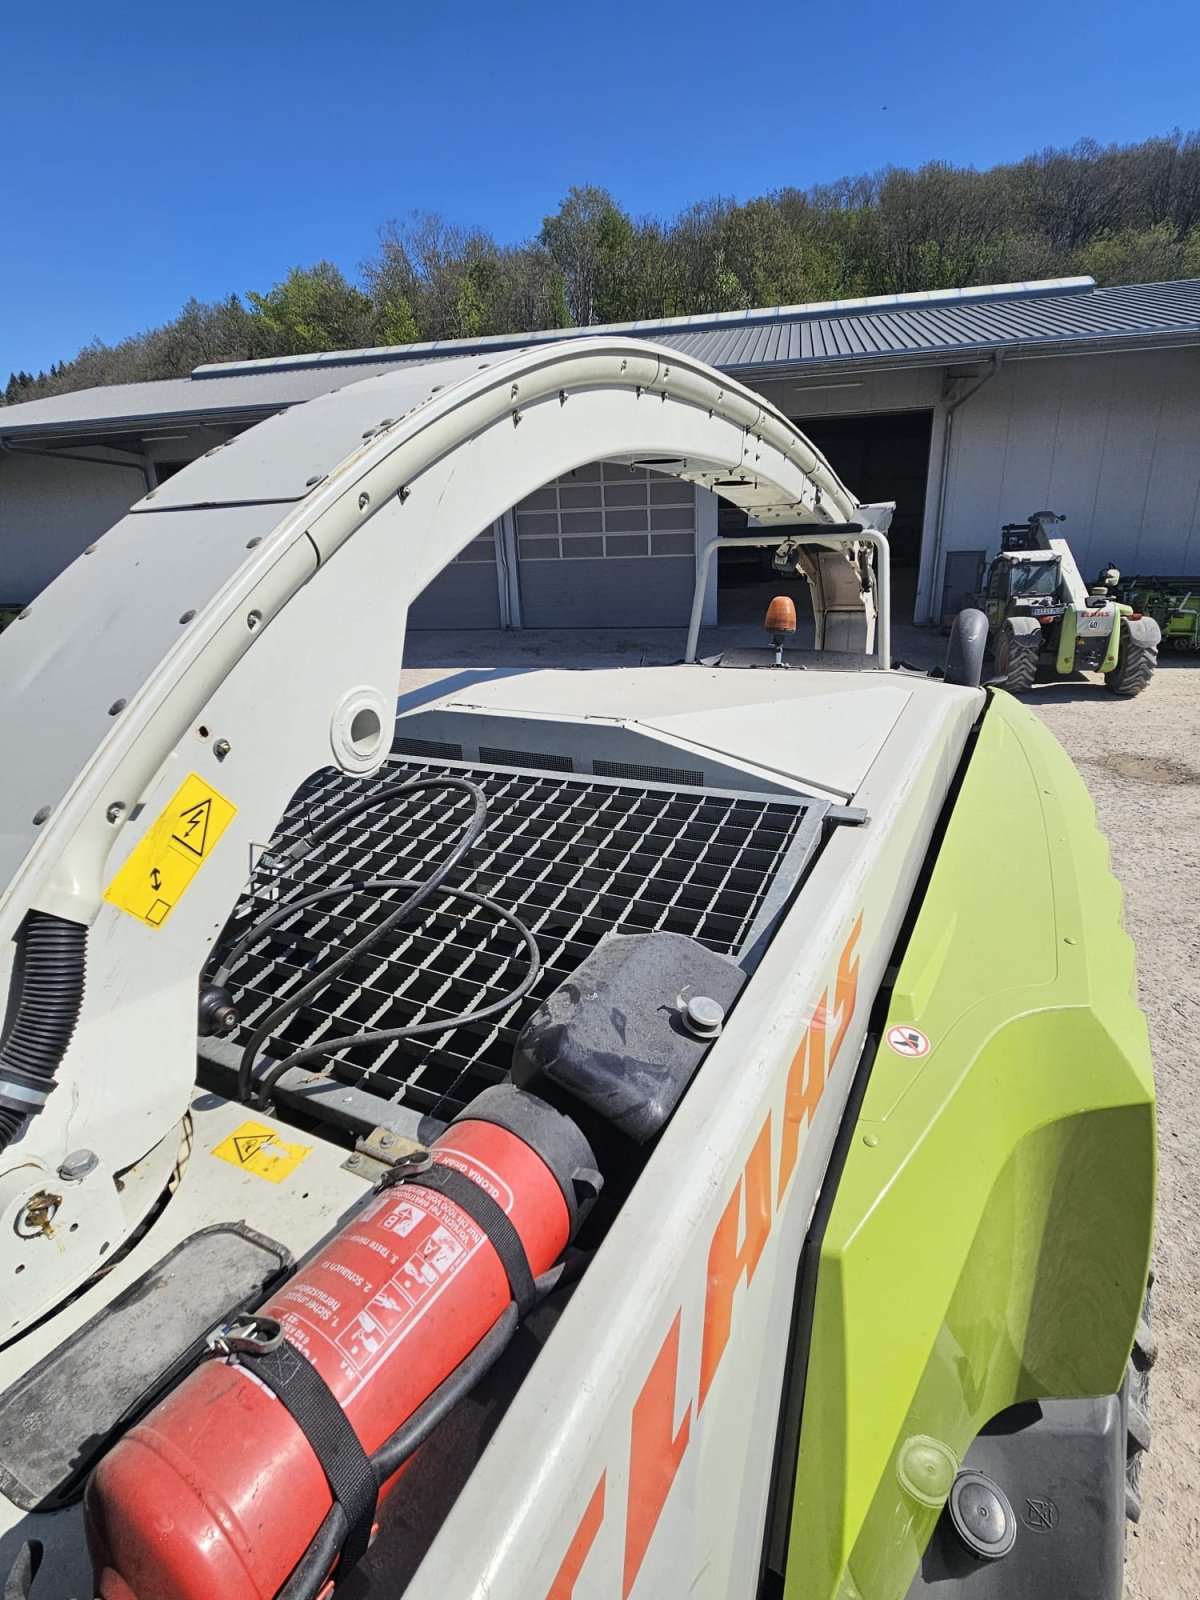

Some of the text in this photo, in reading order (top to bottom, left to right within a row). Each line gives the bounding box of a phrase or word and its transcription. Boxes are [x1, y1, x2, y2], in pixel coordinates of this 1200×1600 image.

[1089, 621, 1098, 629] 40
[441, 1156, 467, 1172] GmbH
[466, 1167, 500, 1199] GLORIA
[439, 1202, 457, 1217] 1000
[455, 1215, 468, 1228] bis
[367, 1240, 390, 1258] Taste
[389, 1253, 399, 1264] 3.
[328, 1262, 364, 1286] Schlauch
[362, 1281, 373, 1293] 2.
[330, 1314, 340, 1327] 1.
